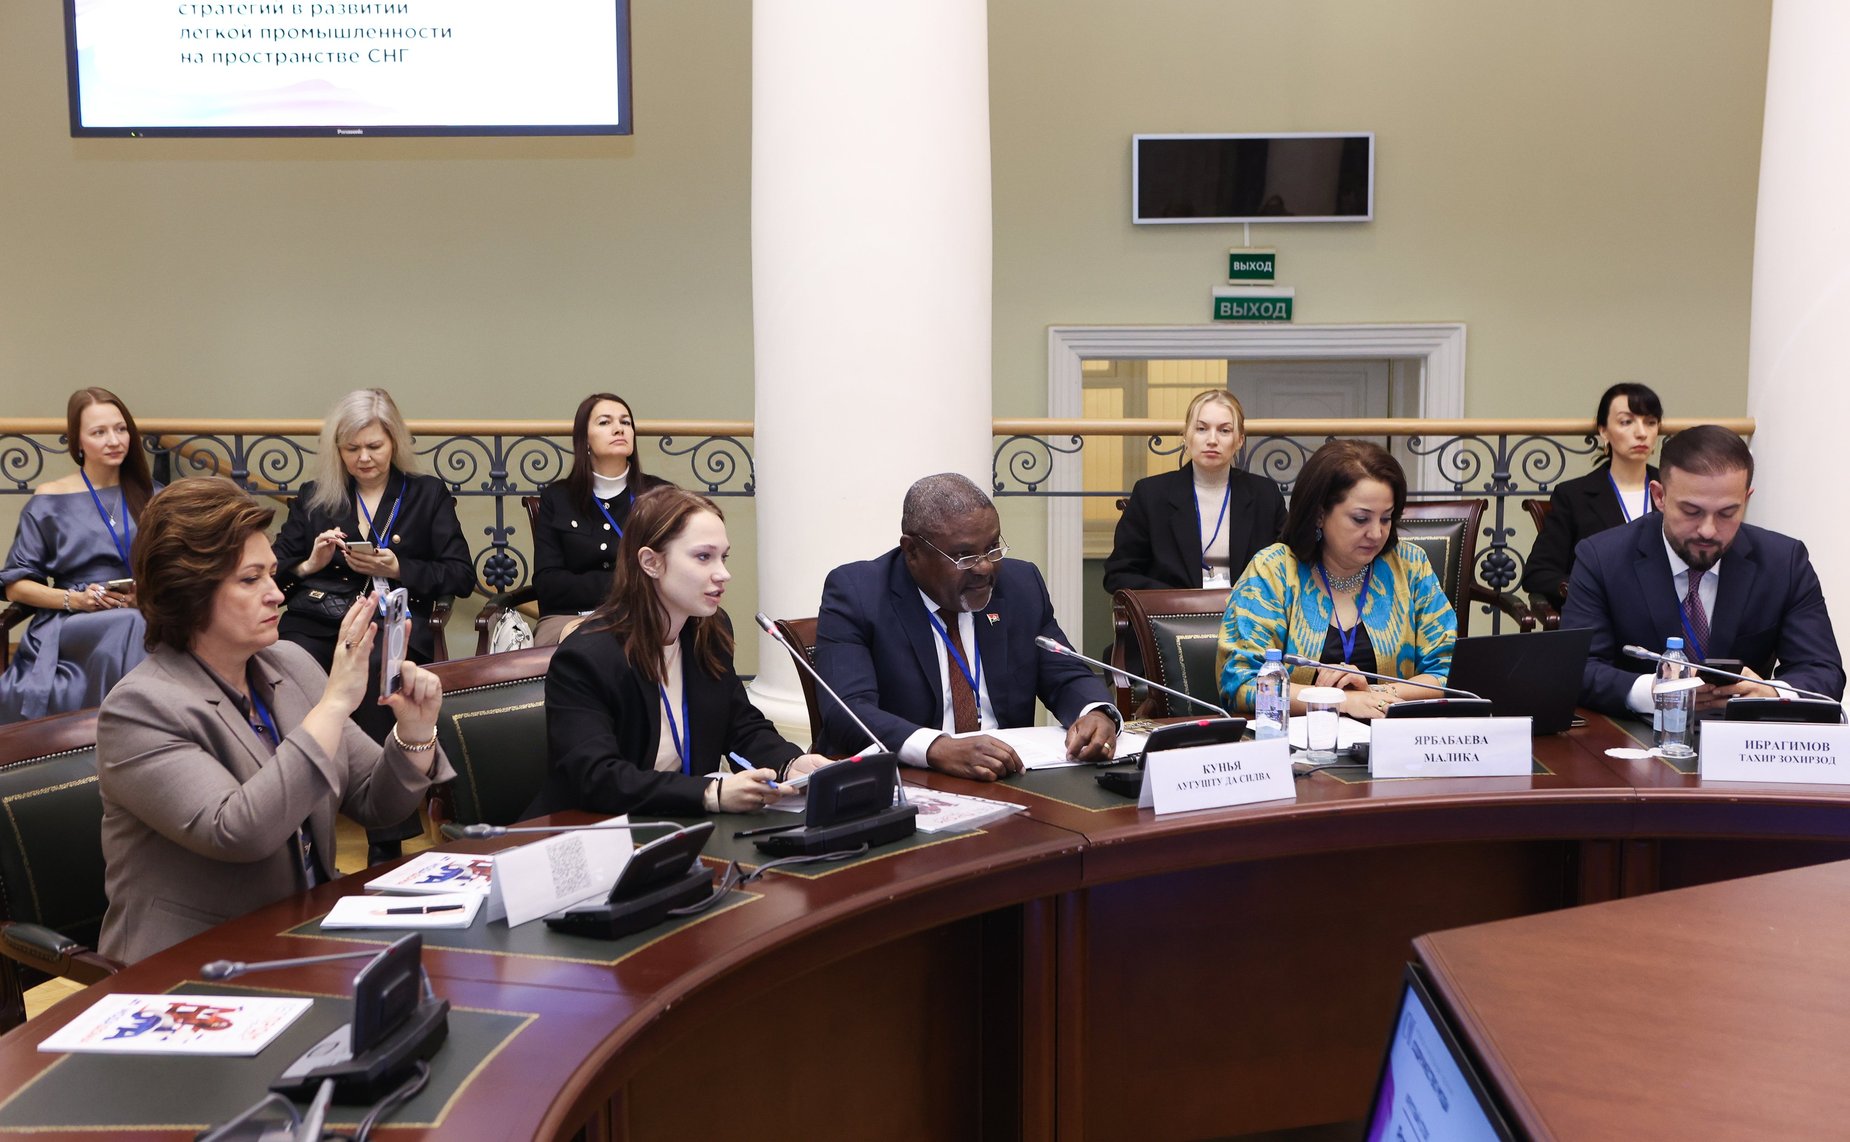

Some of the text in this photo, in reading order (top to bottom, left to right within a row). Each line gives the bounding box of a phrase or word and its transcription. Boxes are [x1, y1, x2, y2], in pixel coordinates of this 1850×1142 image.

[178, 3, 409, 18] стратегии в развитии
[180, 24, 453, 42] легкой промышленности
[181, 48, 410, 66] на пространстве СНГ
[1233, 261, 1272, 272] ВЫХОД
[1220, 302, 1286, 318] ВЫХОД
[1414, 735, 1489, 746] ЯРБАБАЕВА
[1744, 740, 1831, 752] ИБРАГИМОВ
[1424, 752, 1480, 763] МАЛИКА
[1740, 754, 1836, 765] ТАХИР ЗОХИРЗОД
[1202, 761, 1241, 774] КУНЬЯ
[1176, 772, 1271, 791] АУГУШТУ ДА СИЛВА
